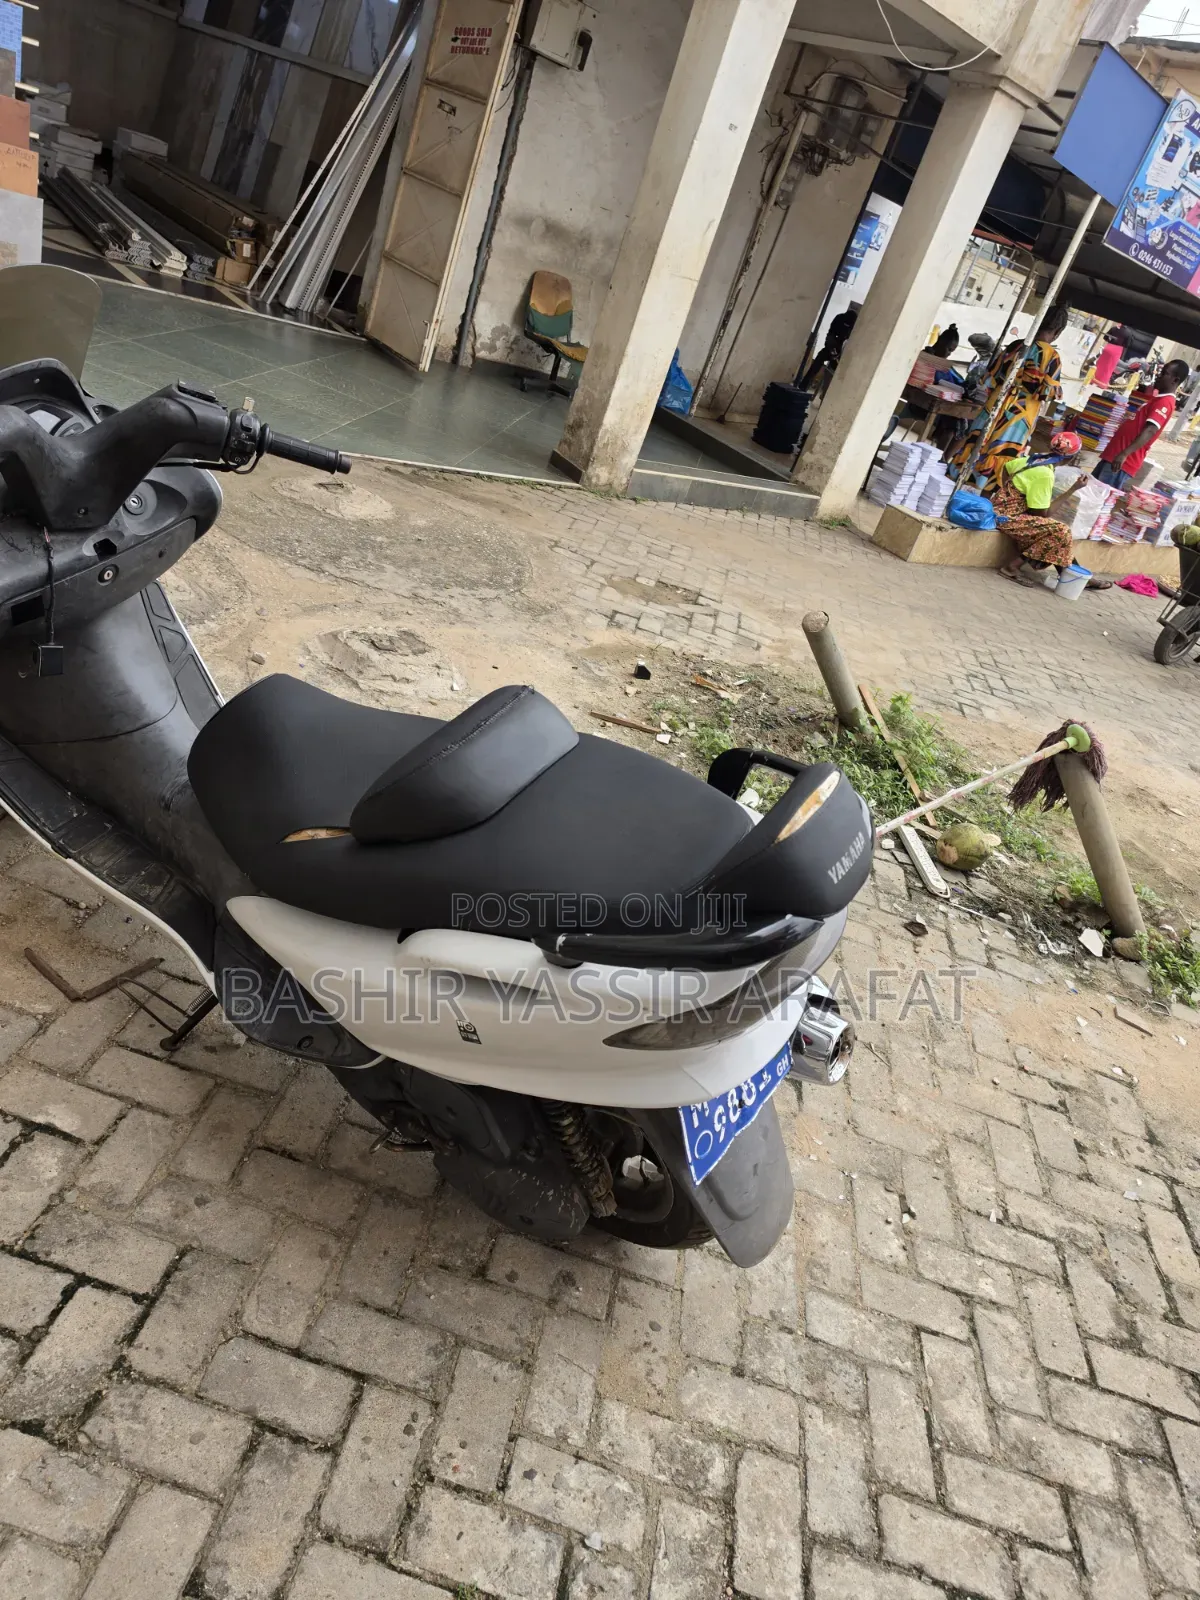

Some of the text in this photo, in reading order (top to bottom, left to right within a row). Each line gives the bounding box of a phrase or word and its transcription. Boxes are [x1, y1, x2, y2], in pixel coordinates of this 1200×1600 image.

[454, 27, 492, 37] GOODS SOLD
[1138, 250, 1173, 275] 0246 431153
[827, 831, 865, 884] YAMAHA
[776, 1054, 789, 1077] GH
